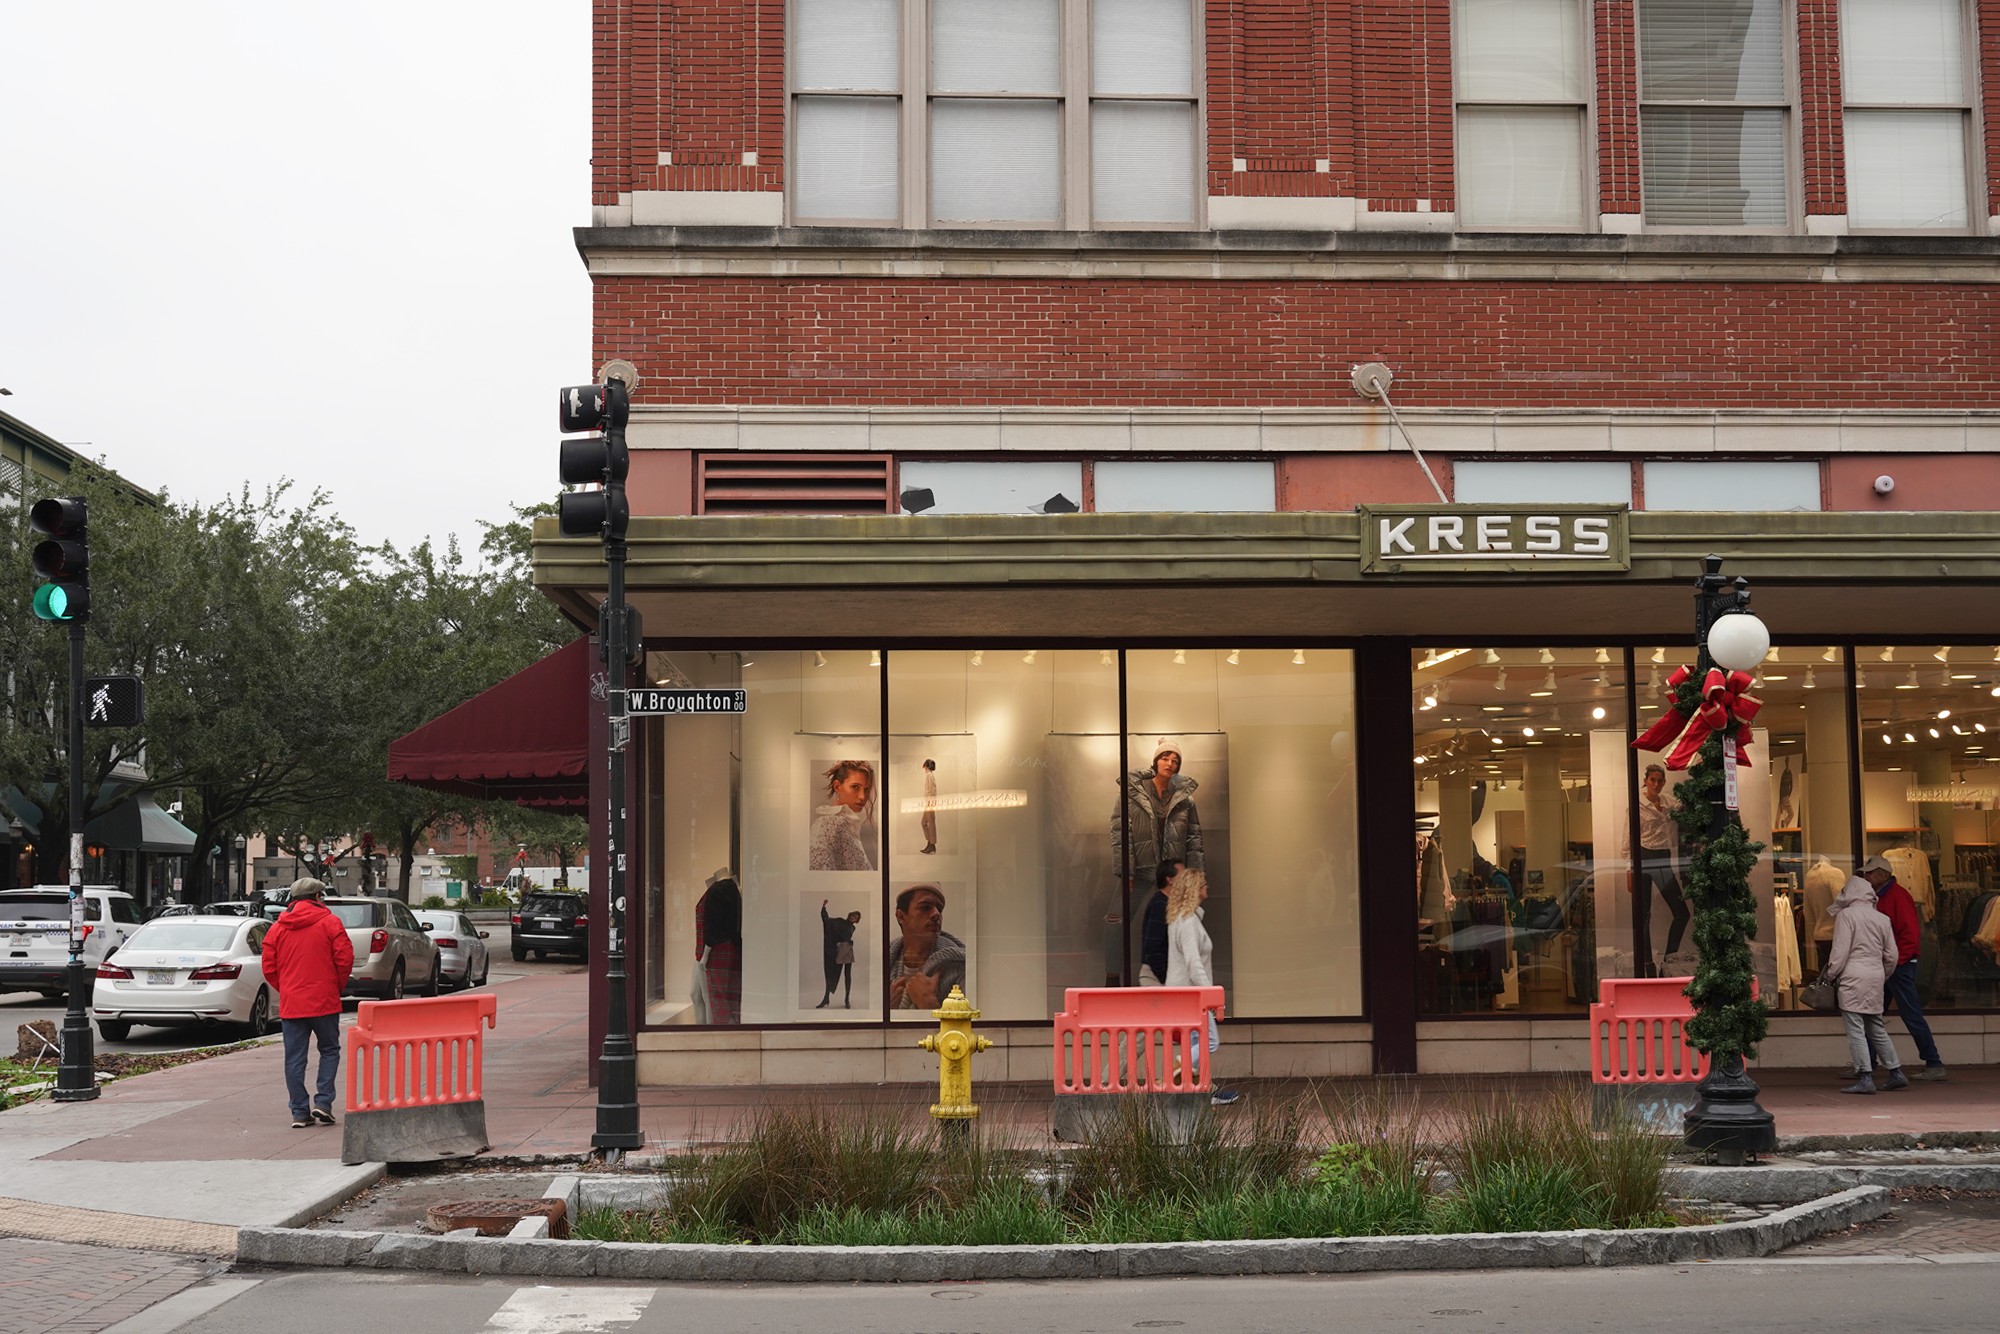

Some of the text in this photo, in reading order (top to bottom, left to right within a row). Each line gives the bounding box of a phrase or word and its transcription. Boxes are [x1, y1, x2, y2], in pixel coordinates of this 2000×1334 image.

[1380, 516, 1609, 554] KRESS
[734, 691, 744, 701] ST
[733, 701, 744, 711] 00
